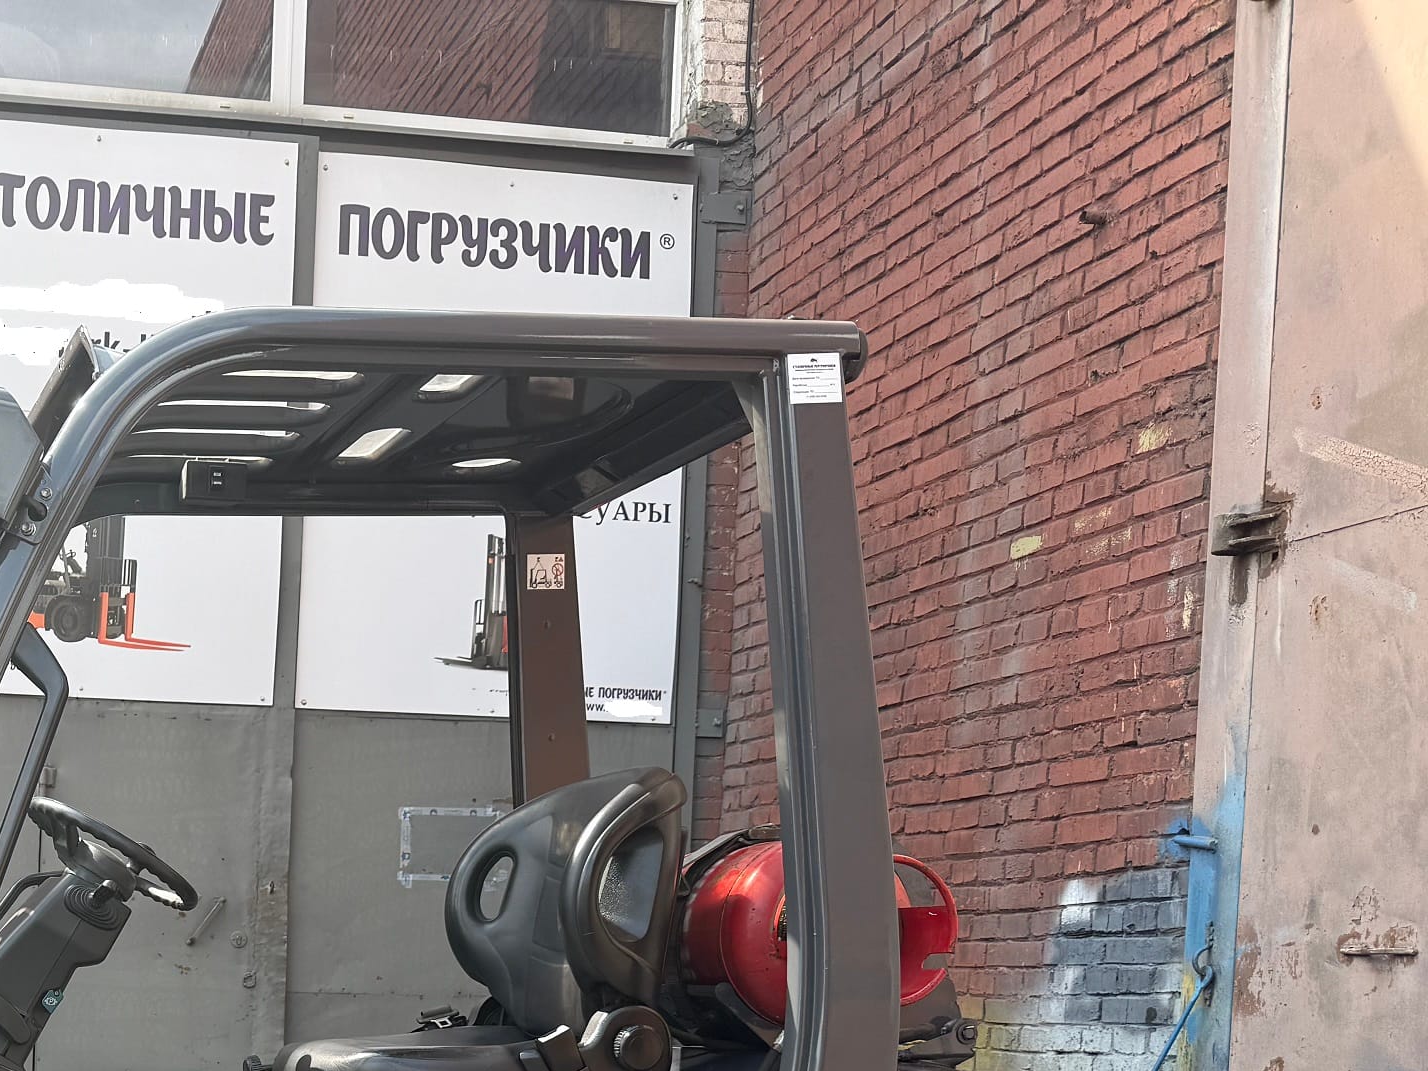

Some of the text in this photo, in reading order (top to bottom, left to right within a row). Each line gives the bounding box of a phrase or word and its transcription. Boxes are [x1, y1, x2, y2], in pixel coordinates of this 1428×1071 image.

[338, 203, 651, 280] ПОГРУЗЧИКИ
[580, 501, 672, 526] УАРЫ
[598, 687, 662, 701] ПОГРУЗЧИКИ
